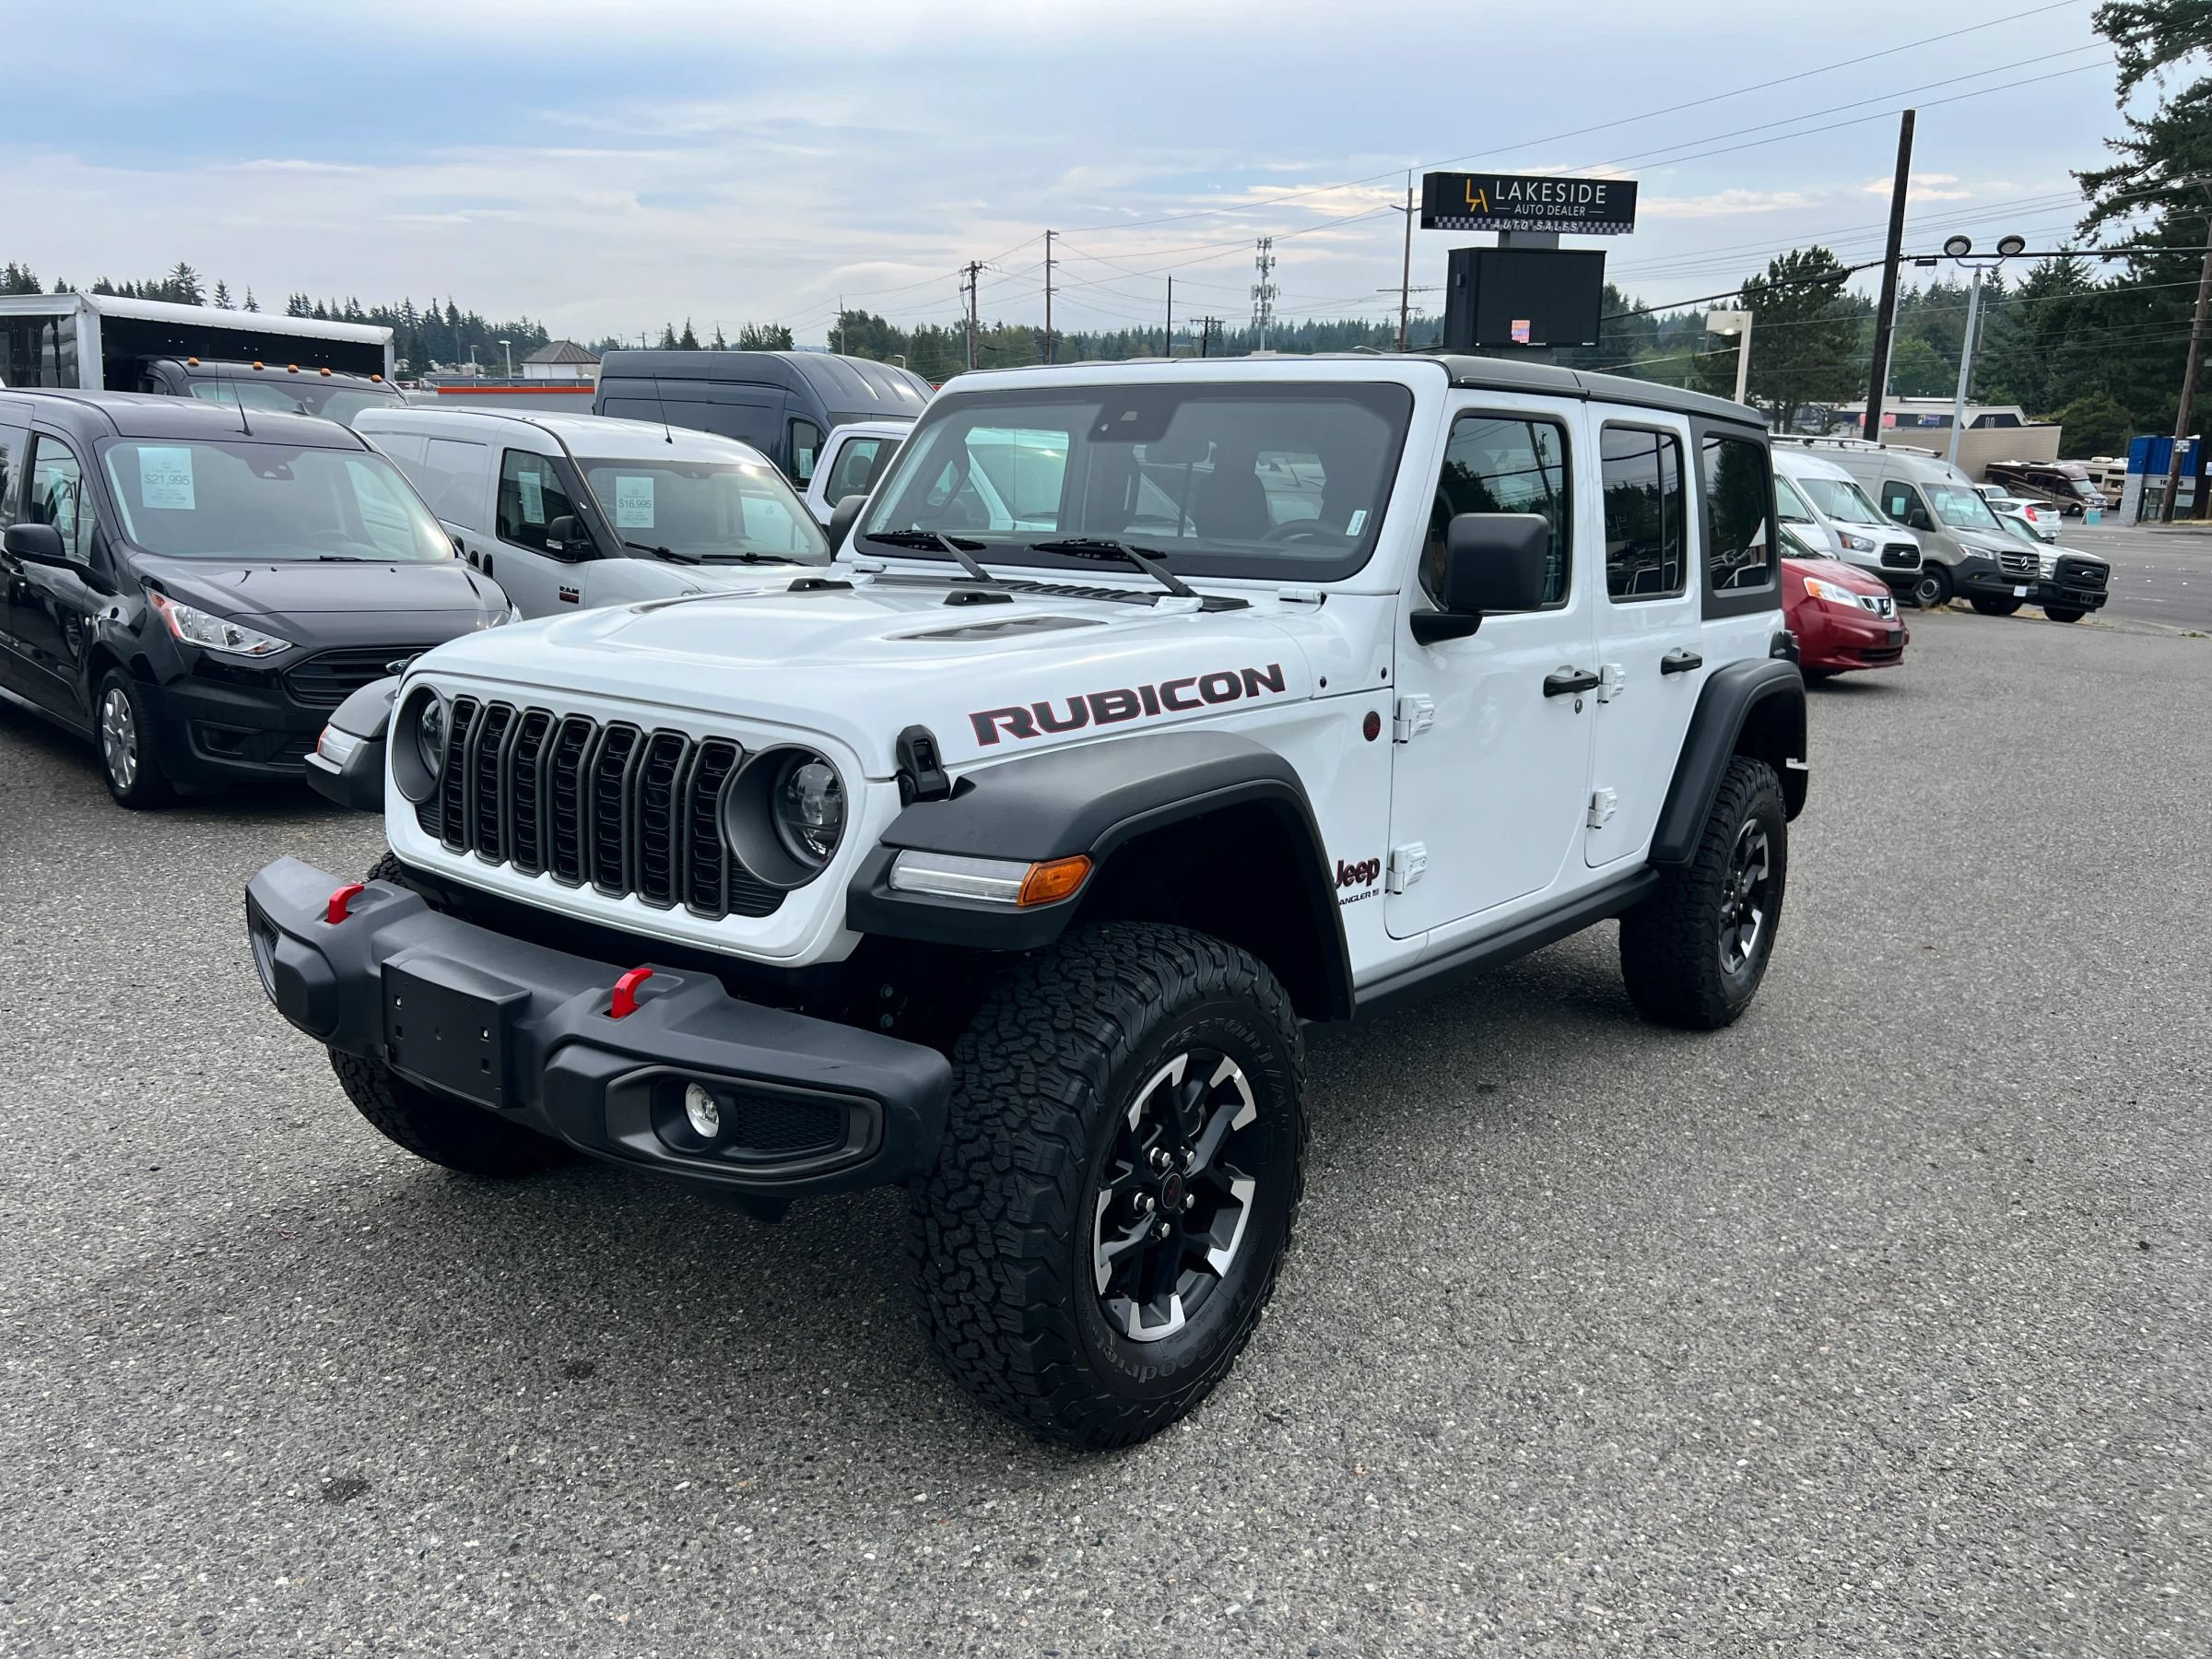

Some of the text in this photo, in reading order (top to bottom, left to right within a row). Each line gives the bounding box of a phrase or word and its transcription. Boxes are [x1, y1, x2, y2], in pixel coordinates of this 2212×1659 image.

[1495, 181, 1606, 204] LAKESIDE
[1514, 204, 1585, 217] AUTO DEALER
[1493, 220, 1578, 232] AUTO SALES
[145, 474, 190, 486] $21,995
[618, 499, 652, 509] $16,995
[559, 585, 579, 594] RAM
[968, 663, 1286, 747] RUBICON
[1335, 857, 1380, 889] Jeep
[1339, 891, 1371, 905] ANGLER
